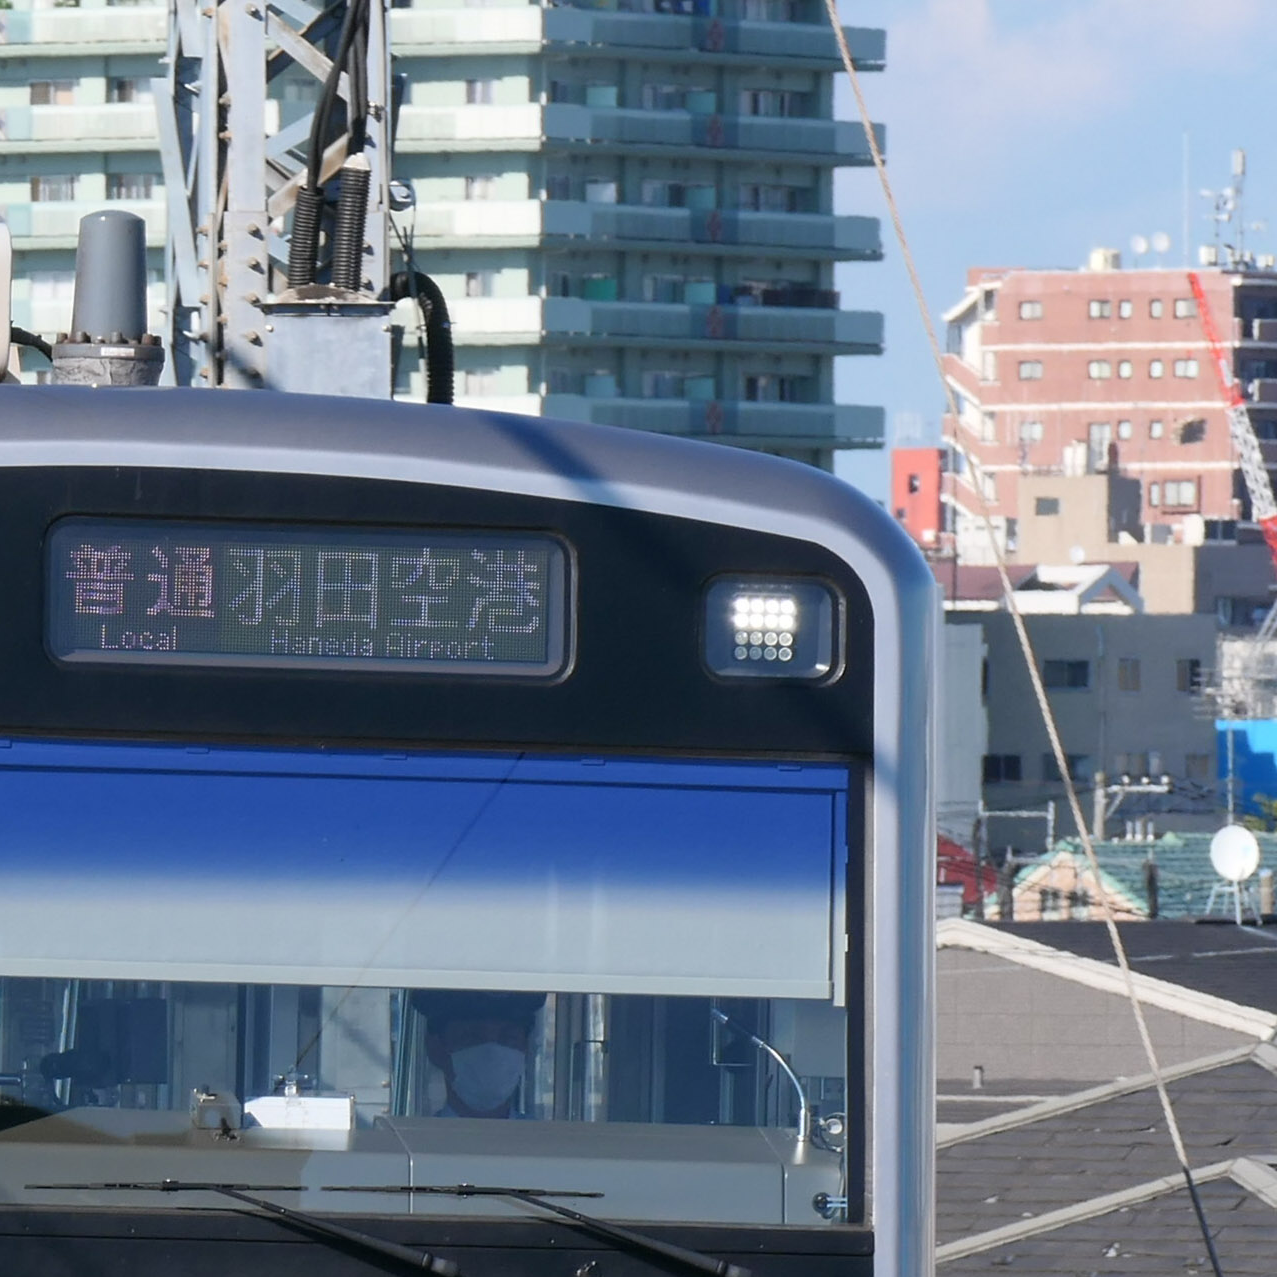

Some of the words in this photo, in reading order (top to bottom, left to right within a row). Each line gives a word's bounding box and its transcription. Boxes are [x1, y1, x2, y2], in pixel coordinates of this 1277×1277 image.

[65, 544, 215, 618] 普通
[228, 547, 540, 633] 羽田空港
[101, 623, 178, 651] Local
[270, 628, 375, 658] Haneda
[386, 631, 496, 662] Airport
